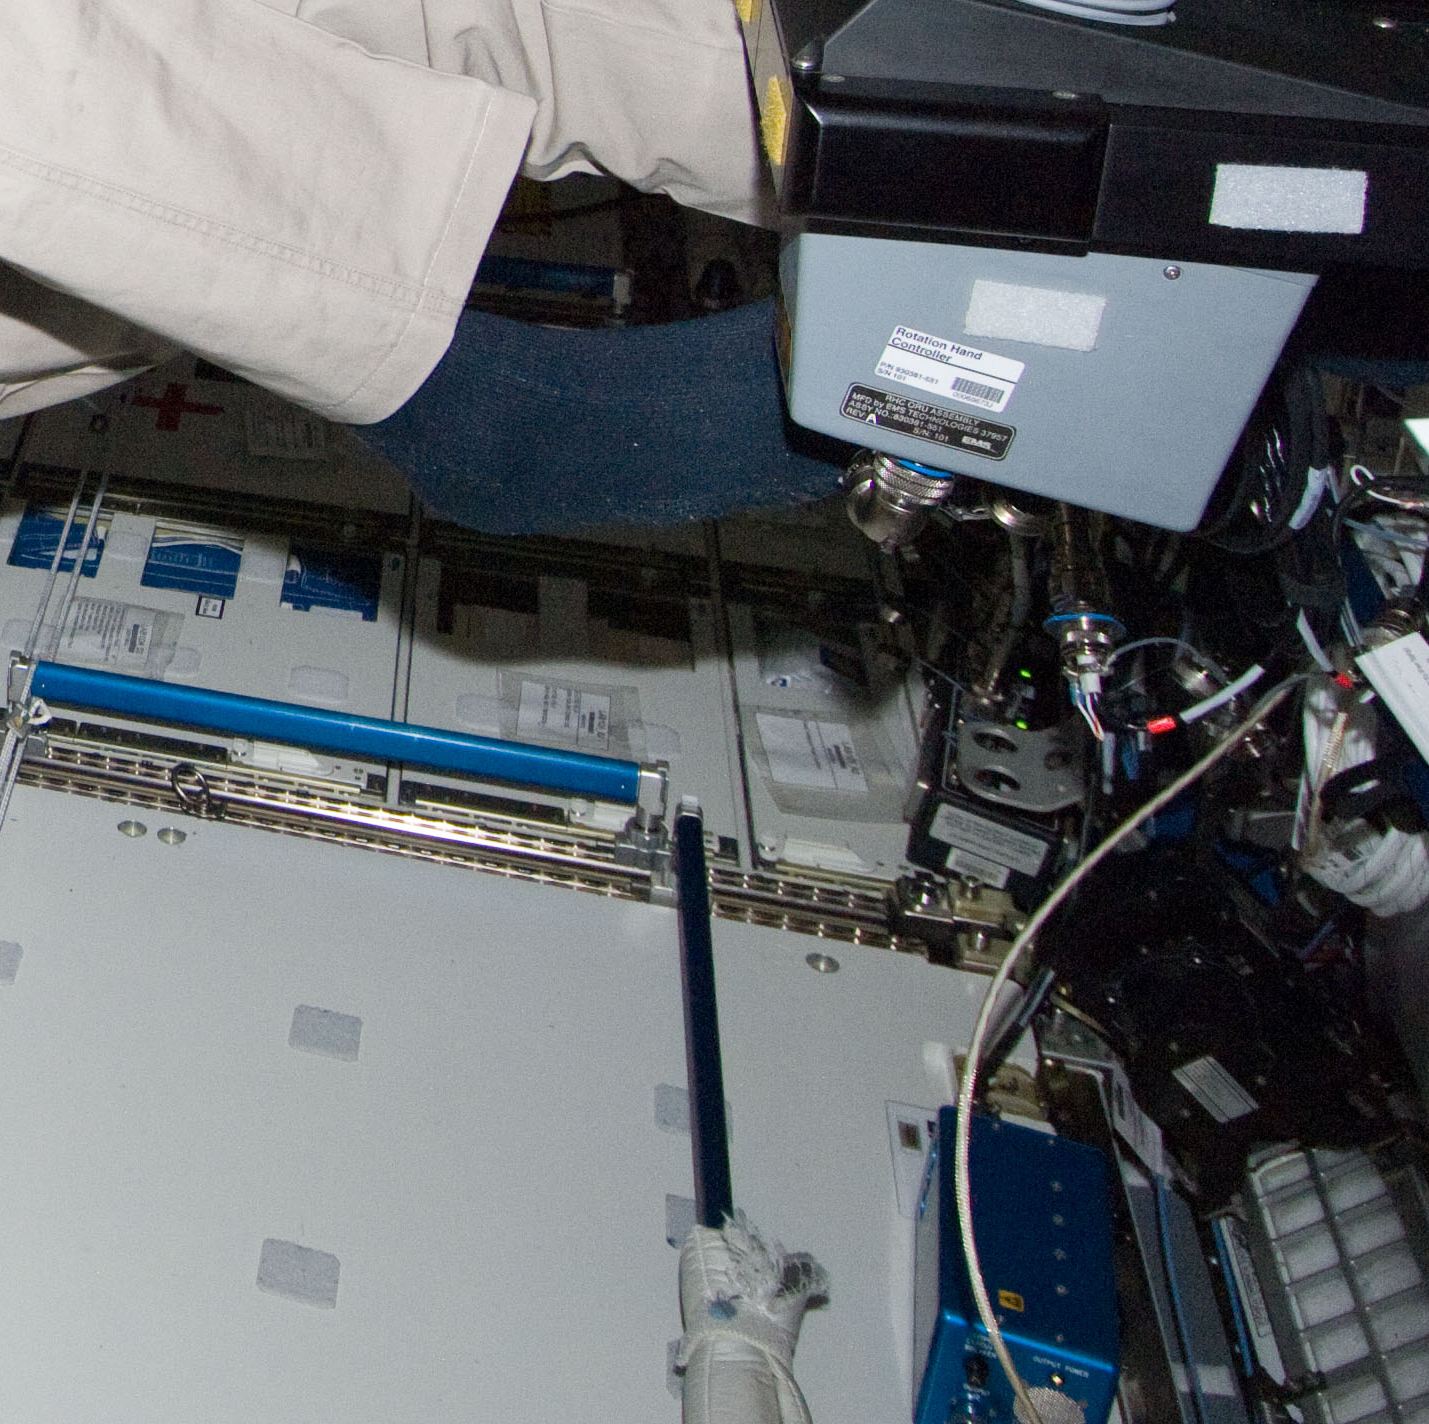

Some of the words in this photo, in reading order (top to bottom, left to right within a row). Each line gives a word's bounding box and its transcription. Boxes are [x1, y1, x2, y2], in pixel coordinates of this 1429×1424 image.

[891, 337, 953, 363] Controller
[896, 327, 948, 350] Rotation
[950, 344, 983, 361] Hand
[877, 367, 892, 378] S/N
[849, 399, 873, 413] ASSY
[851, 392, 872, 405] MFD
[873, 398, 885, 410] by
[886, 403, 907, 414] EMS
[908, 409, 980, 435] TECHNOLOGIES
[980, 427, 1009, 443] 37957
[866, 412, 878, 425] A
[885, 393, 907, 407] RHC
[907, 401, 929, 414] ORU
[931, 406, 981, 427] ASSEMBLY
[934, 433, 949, 444] 101
[1031, 1354, 1062, 1370] OUTPUT
[1064, 1364, 1090, 1379] POWER
